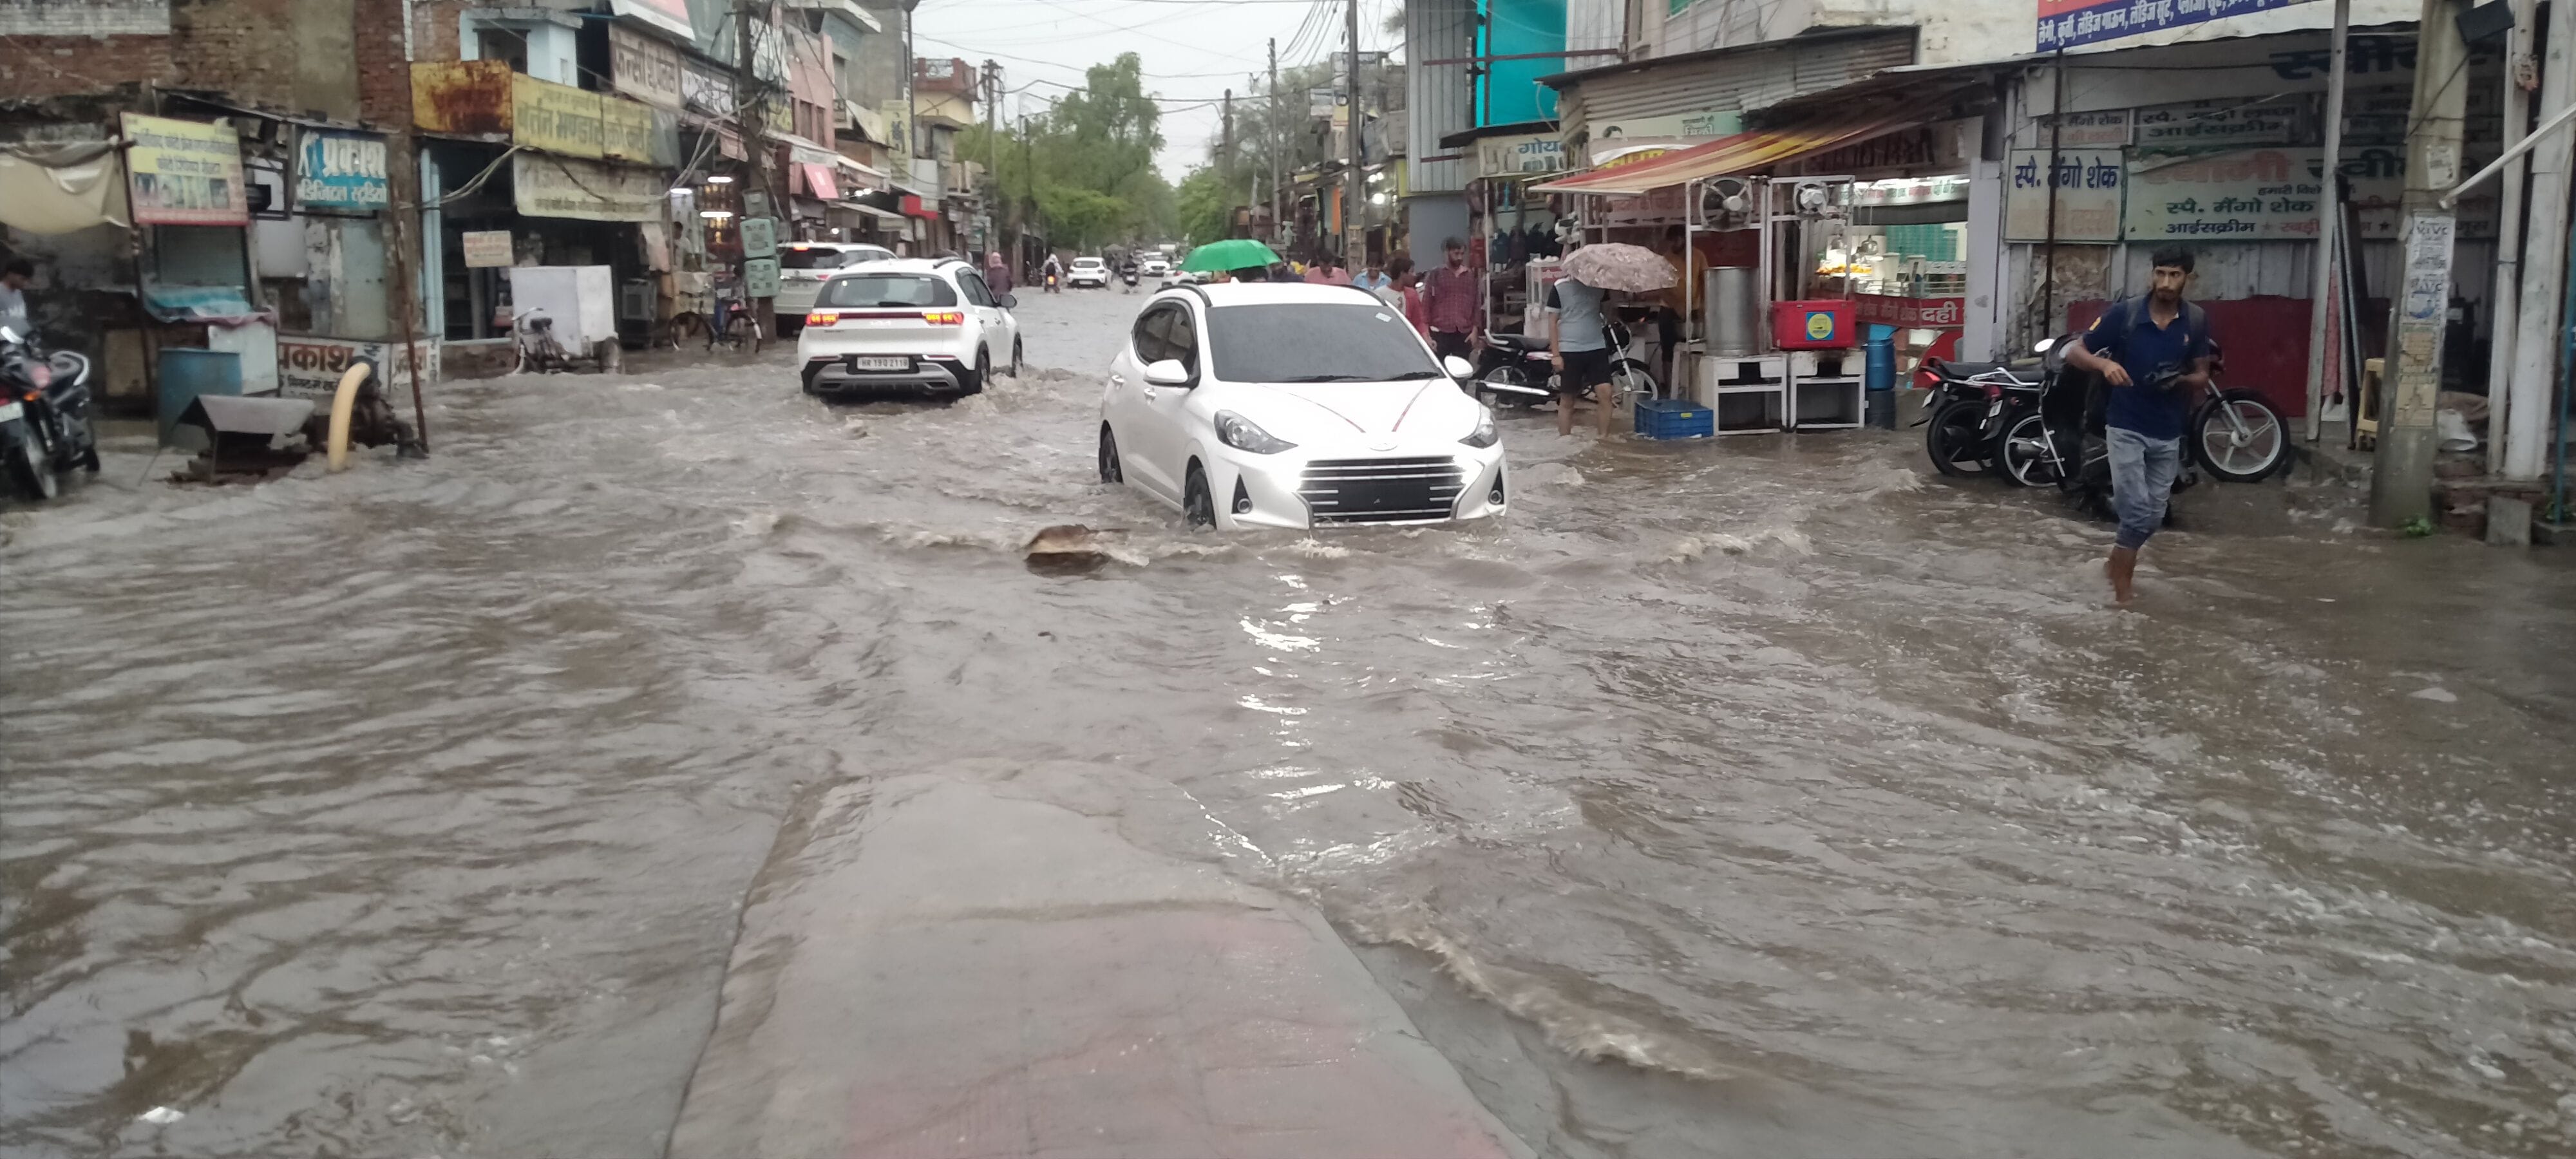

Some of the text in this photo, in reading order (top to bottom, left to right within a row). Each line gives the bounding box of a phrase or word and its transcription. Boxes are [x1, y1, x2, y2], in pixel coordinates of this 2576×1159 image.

[1518, 137, 1565, 155] गोय
[2087, 155, 2119, 189] शेक
[2166, 198, 2204, 214] स्पै.
[2270, 196, 2317, 213] शेक
[1922, 300, 1958, 323] दही
